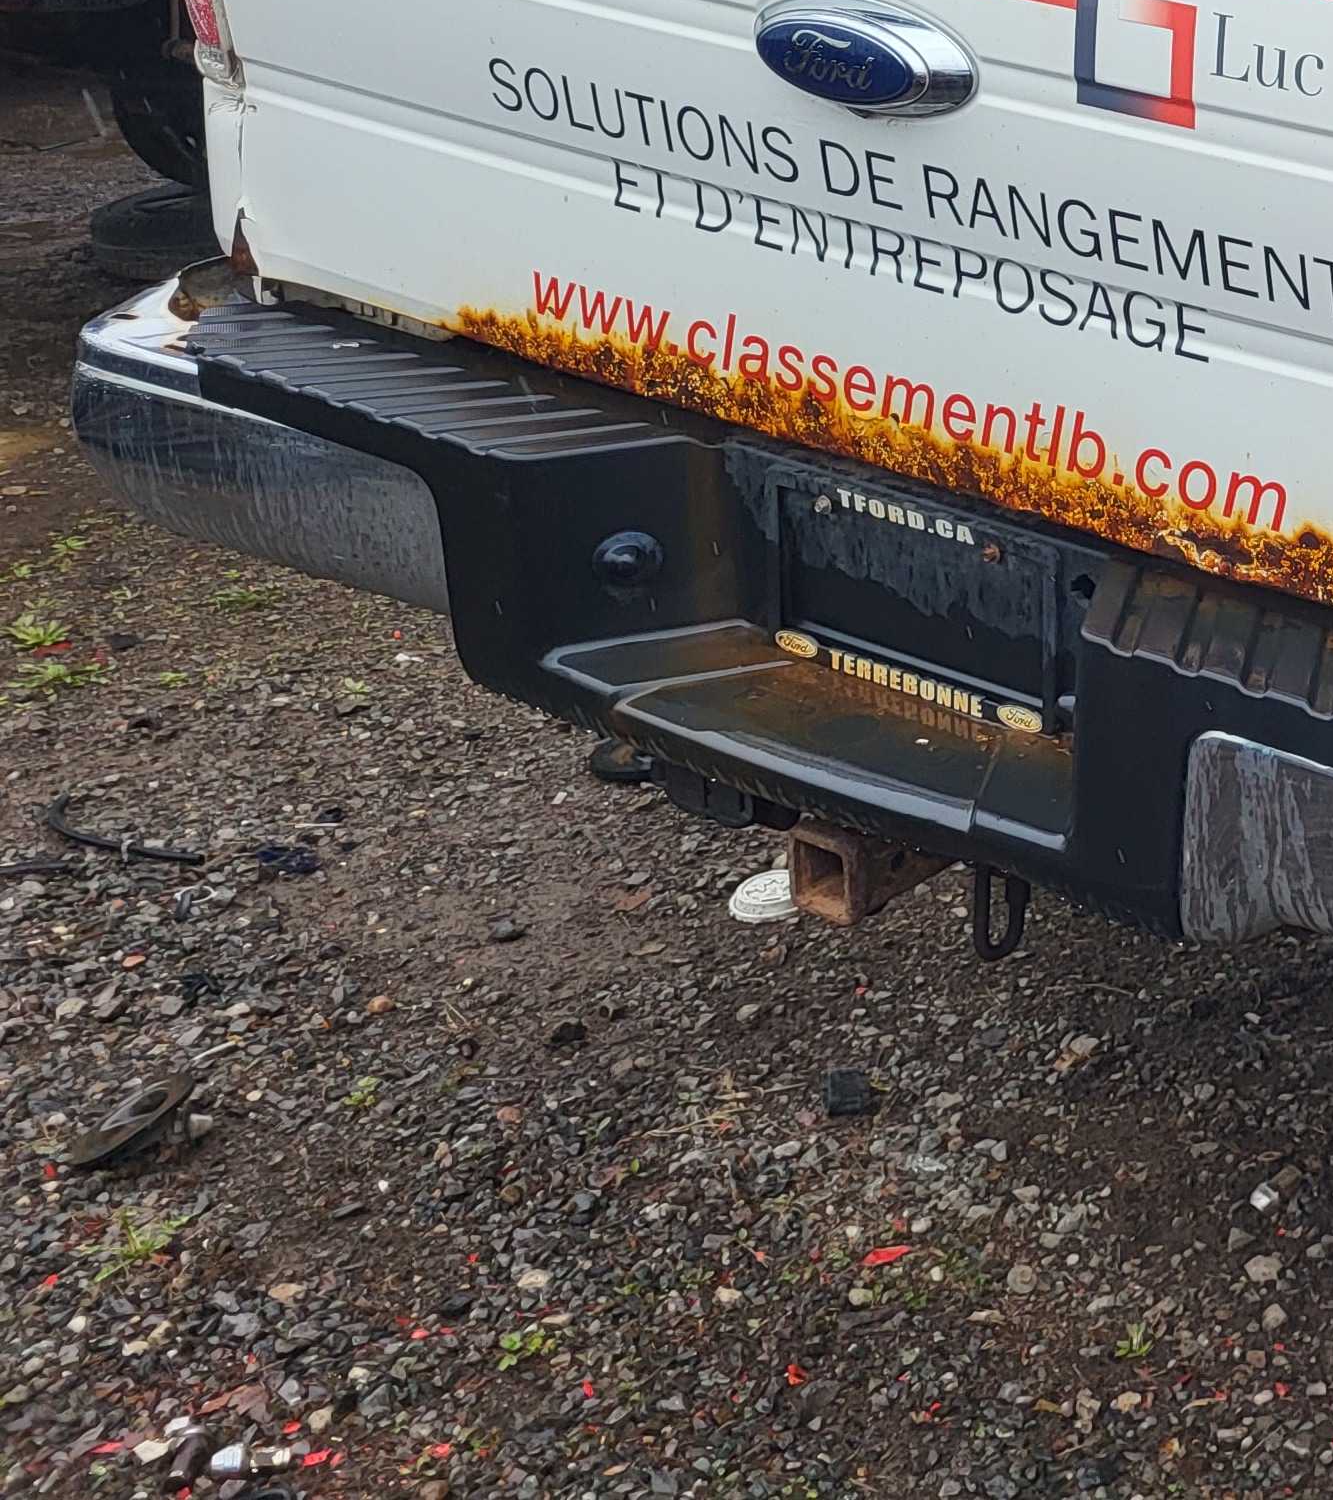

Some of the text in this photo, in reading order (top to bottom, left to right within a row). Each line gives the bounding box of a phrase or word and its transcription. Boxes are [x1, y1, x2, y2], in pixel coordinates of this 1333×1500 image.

[783, 29, 875, 91] Ford
[1209, 12, 1324, 98] Luc
[489, 57, 800, 183] SOLUTIONS
[819, 140, 903, 211] DE
[613, 159, 1210, 363] ET D'ENTREPOSAGE
[531, 270, 1289, 531] www.classementlb.com
[836, 488, 976, 546] TFORD.CA
[780, 634, 1034, 729] Ford TERREBONNE Ford
